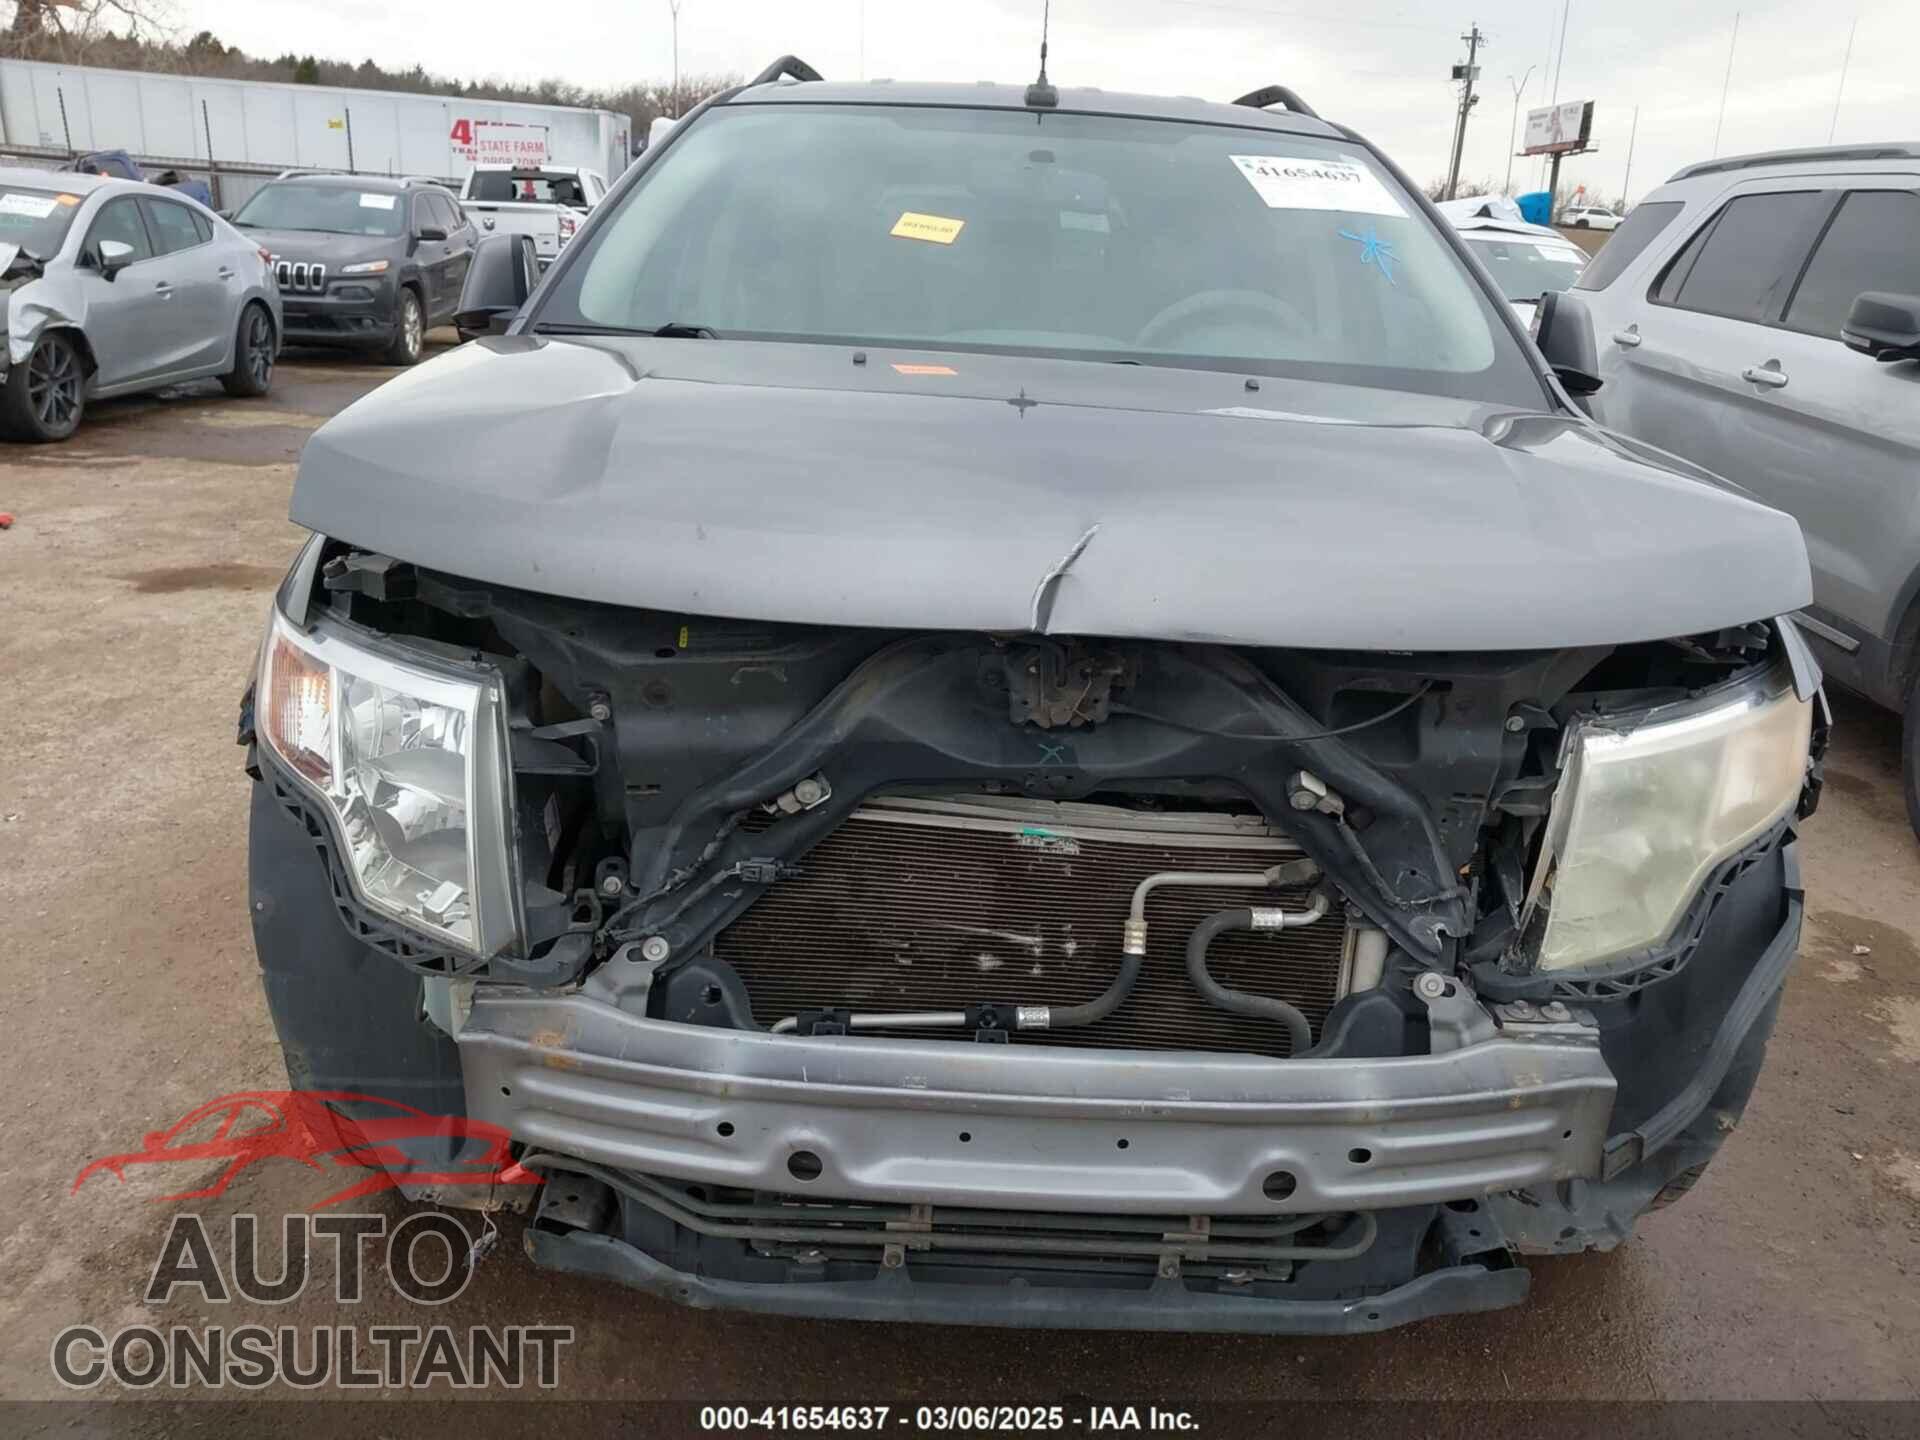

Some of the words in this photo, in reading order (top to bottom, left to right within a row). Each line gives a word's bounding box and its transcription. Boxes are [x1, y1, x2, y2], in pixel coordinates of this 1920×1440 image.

[450, 119, 473, 145] 4
[479, 140, 511, 152] STATE
[514, 141, 545, 153] FARM
[1256, 166, 1361, 183] 41654637
